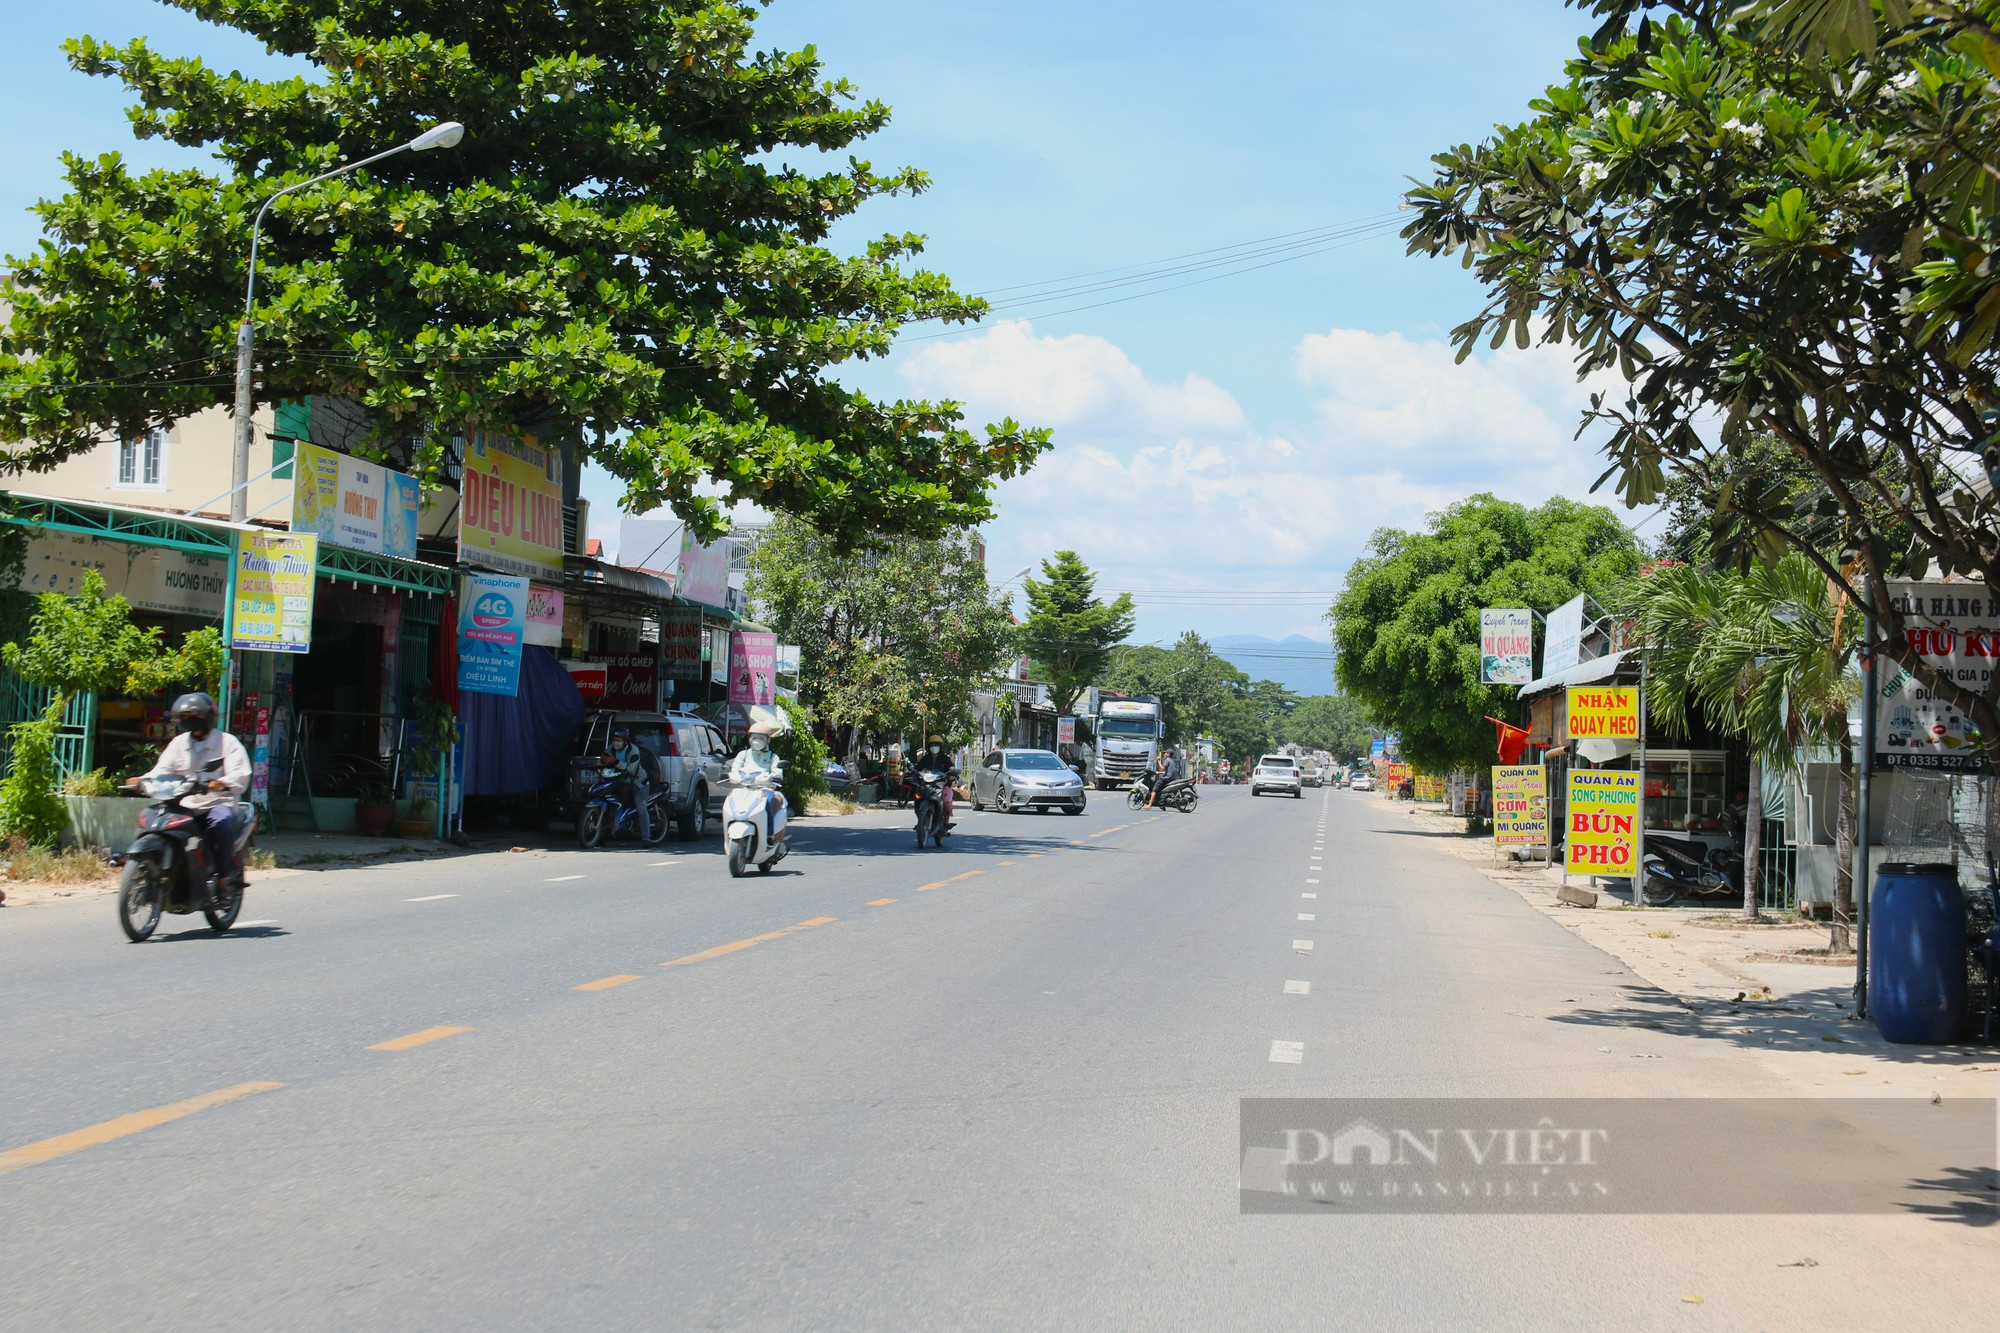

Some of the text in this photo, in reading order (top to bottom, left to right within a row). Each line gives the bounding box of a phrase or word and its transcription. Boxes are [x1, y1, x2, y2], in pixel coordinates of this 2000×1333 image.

[464, 466, 562, 550] DIỆU LINH
[242, 550, 310, 578] Hương Thủy
[166, 570, 224, 594] HƯƠNG THỦY
[474, 576, 520, 588] vinaphone
[478, 598, 507, 615] 4G
[1930, 594, 1982, 617] HÀNG
[1484, 614, 1529, 629] Quỳnh Trang
[664, 622, 698, 640] QUANG
[1904, 620, 1958, 656] HỦ
[1497, 629, 1530, 658] QUẢNG
[664, 645, 697, 660] CHUNG
[490, 658, 502, 666] SIM
[631, 654, 654, 668] GHÉP
[734, 653, 746, 668] BO
[748, 654, 773, 668] SHOP
[466, 672, 506, 684] DIỆU LINH
[1882, 666, 1912, 698] CHUYÊ
[1958, 669, 1977, 680] GIA
[1578, 690, 1628, 711] NHẬN
[1570, 716, 1636, 736] QUAY HEO
[1887, 754, 1906, 766] ĐT:
[1910, 756, 1938, 766] 0335
[1942, 756, 1964, 767] 527
[1390, 766, 1404, 776] CƠM
[1496, 778, 1544, 792] Quỳnh Trang
[1574, 774, 1634, 786] QUÁN ĂN
[1572, 789, 1636, 804] SONG PHƯƠNG
[1496, 800, 1527, 812] CƠM
[1572, 808, 1634, 834] BÚN
[1570, 838, 1630, 865] PHỞ
